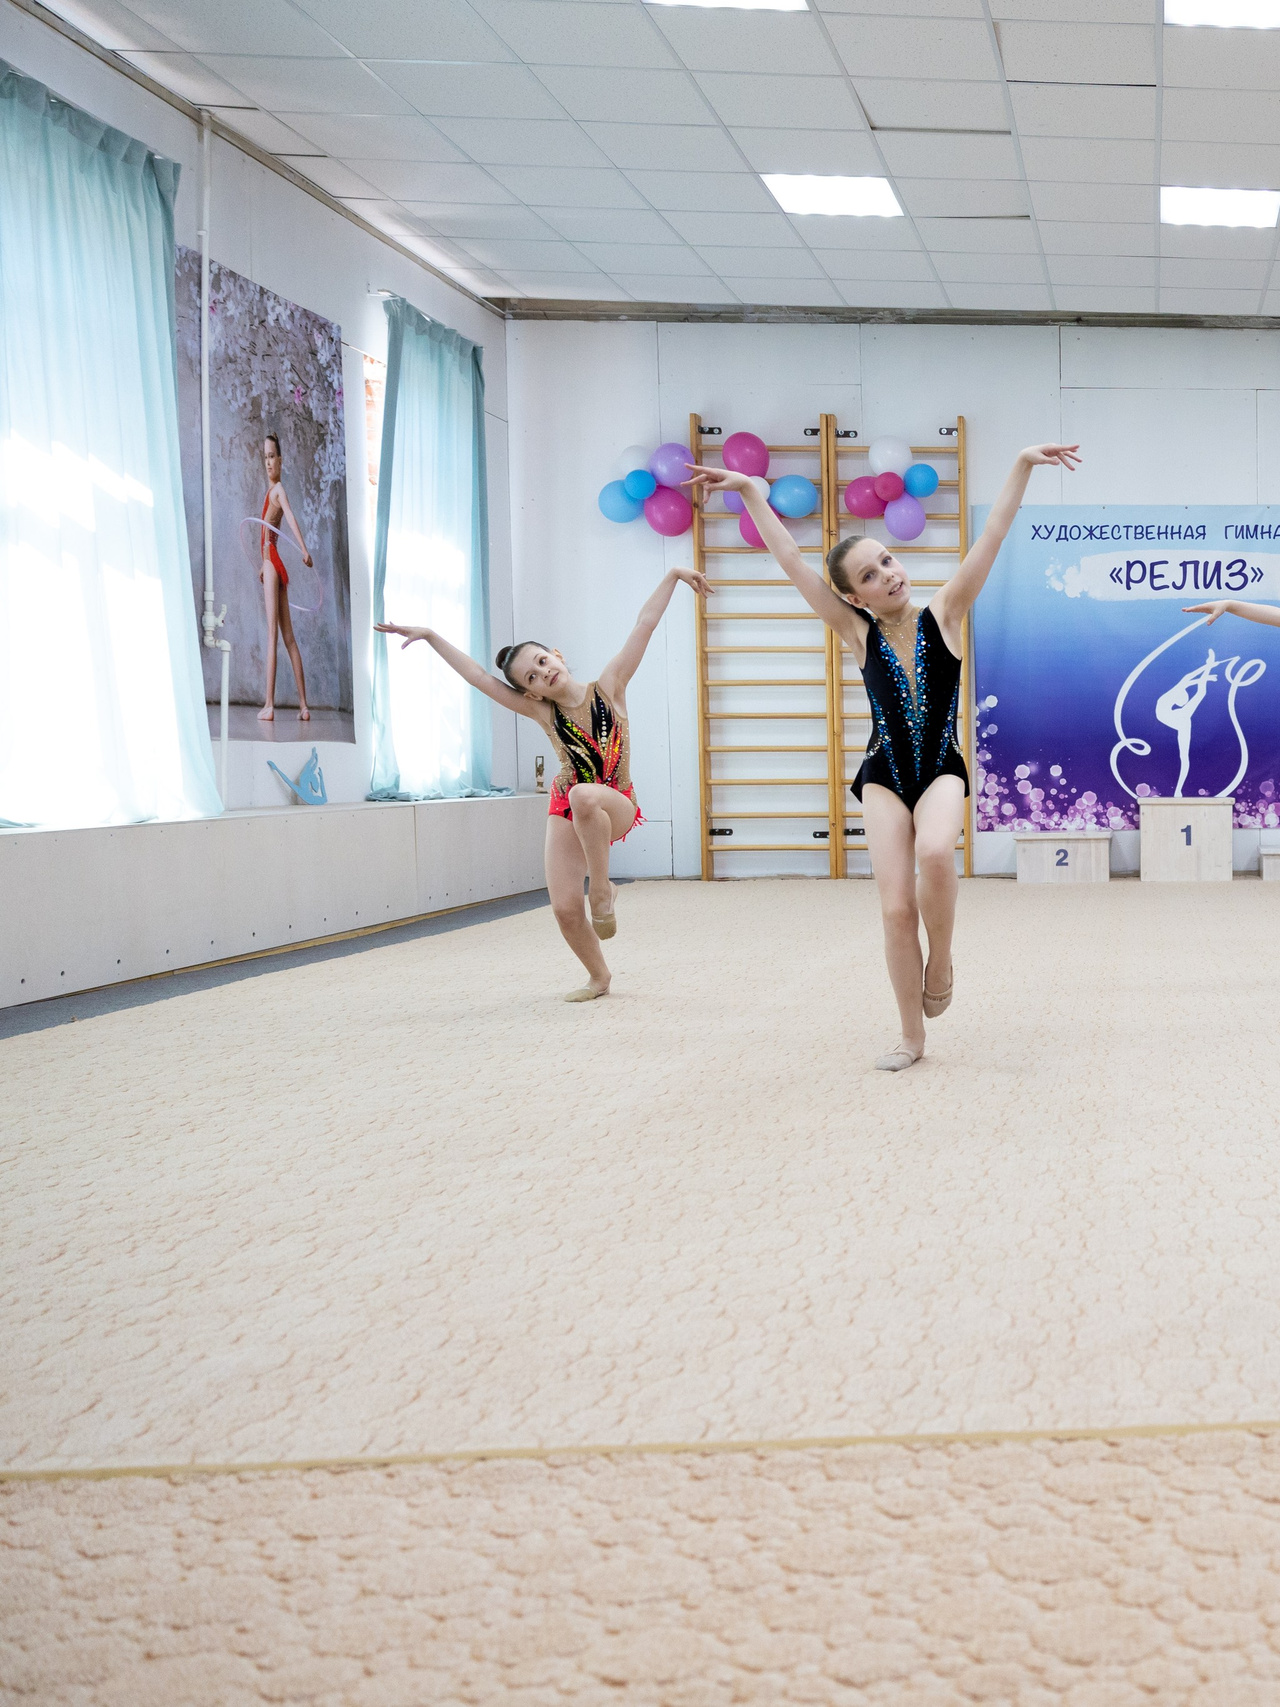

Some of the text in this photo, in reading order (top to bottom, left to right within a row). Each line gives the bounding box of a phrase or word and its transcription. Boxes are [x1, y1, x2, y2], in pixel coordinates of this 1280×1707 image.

[1031, 524, 1207, 542] ХУДОЖЕСТВЕННАЯ
[1109, 558, 1264, 591] «РЕЛИЗ»
[1181, 825, 1192, 846] 1
[1055, 848, 1069, 866] 2
